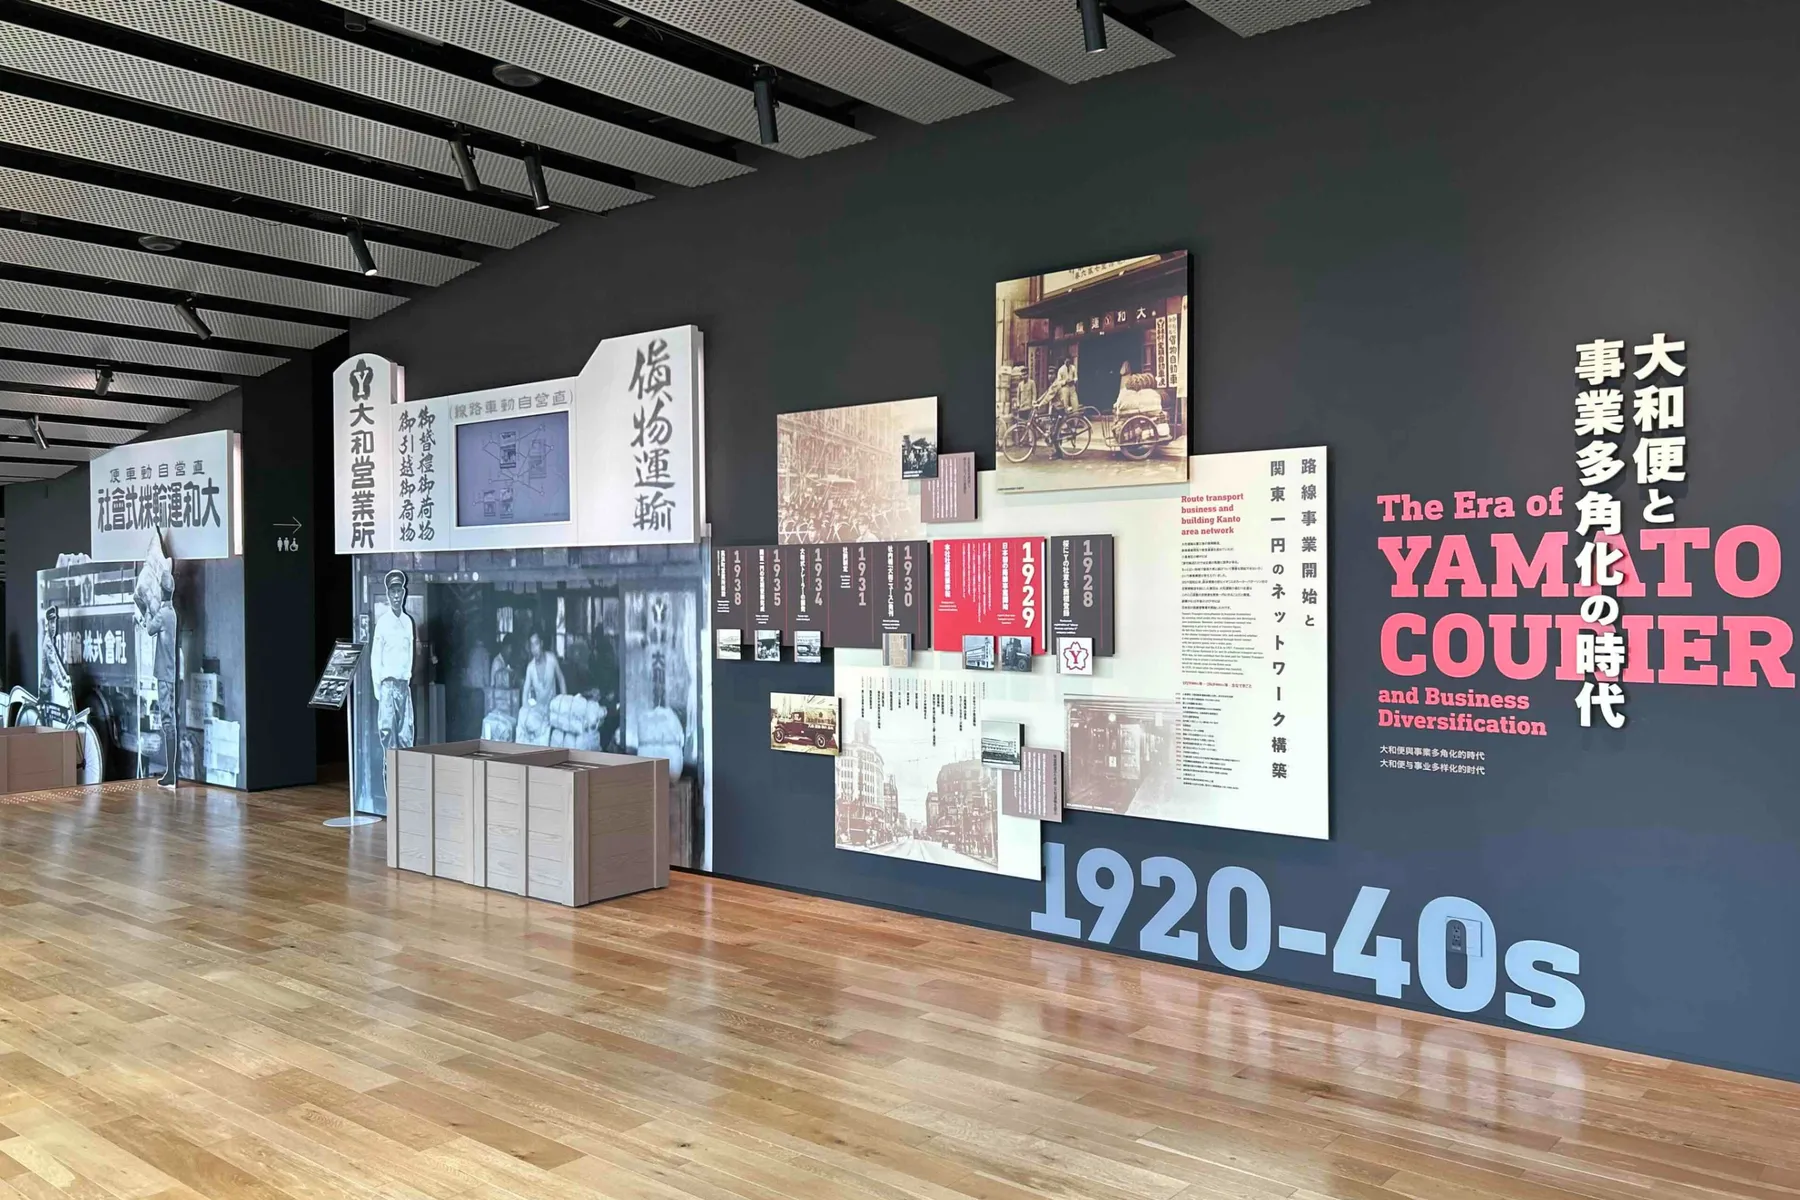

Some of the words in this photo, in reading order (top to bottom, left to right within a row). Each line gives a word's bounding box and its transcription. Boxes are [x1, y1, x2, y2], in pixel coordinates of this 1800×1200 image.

[628, 337, 677, 533] 貨物運輸
[1633, 332, 1686, 525] 大和便と
[350, 403, 375, 549] 大和営業所
[398, 410, 416, 543] 御引越御荷物
[1181, 494, 1204, 503] Route
[1206, 493, 1244, 504] transport
[1377, 493, 1444, 522] The
[1453, 491, 1515, 519] Era
[1525, 487, 1564, 517] of
[1181, 516, 1215, 526] building
[1216, 515, 1241, 524] Kanto
[1200, 527, 1234, 535] network
[1218, 504, 1234, 512] and
[1574, 338, 1626, 730] 事業多角化の時代
[1301, 458, 1318, 627] 路線事業開始と
[733, 550, 742, 606] 1938
[773, 548, 782, 607] 1935
[814, 547, 823, 607] 1934
[858, 546, 867, 606] 1931
[903, 545, 913, 607] 1930
[1021, 541, 1036, 629] 1929
[1082, 540, 1094, 608] 1928
[1270, 460, 1288, 779] 関東一円のネットワーク構築
[1378, 687, 1419, 705] and
[1425, 687, 1530, 710] Business
[1378, 708, 1547, 737] Diversification
